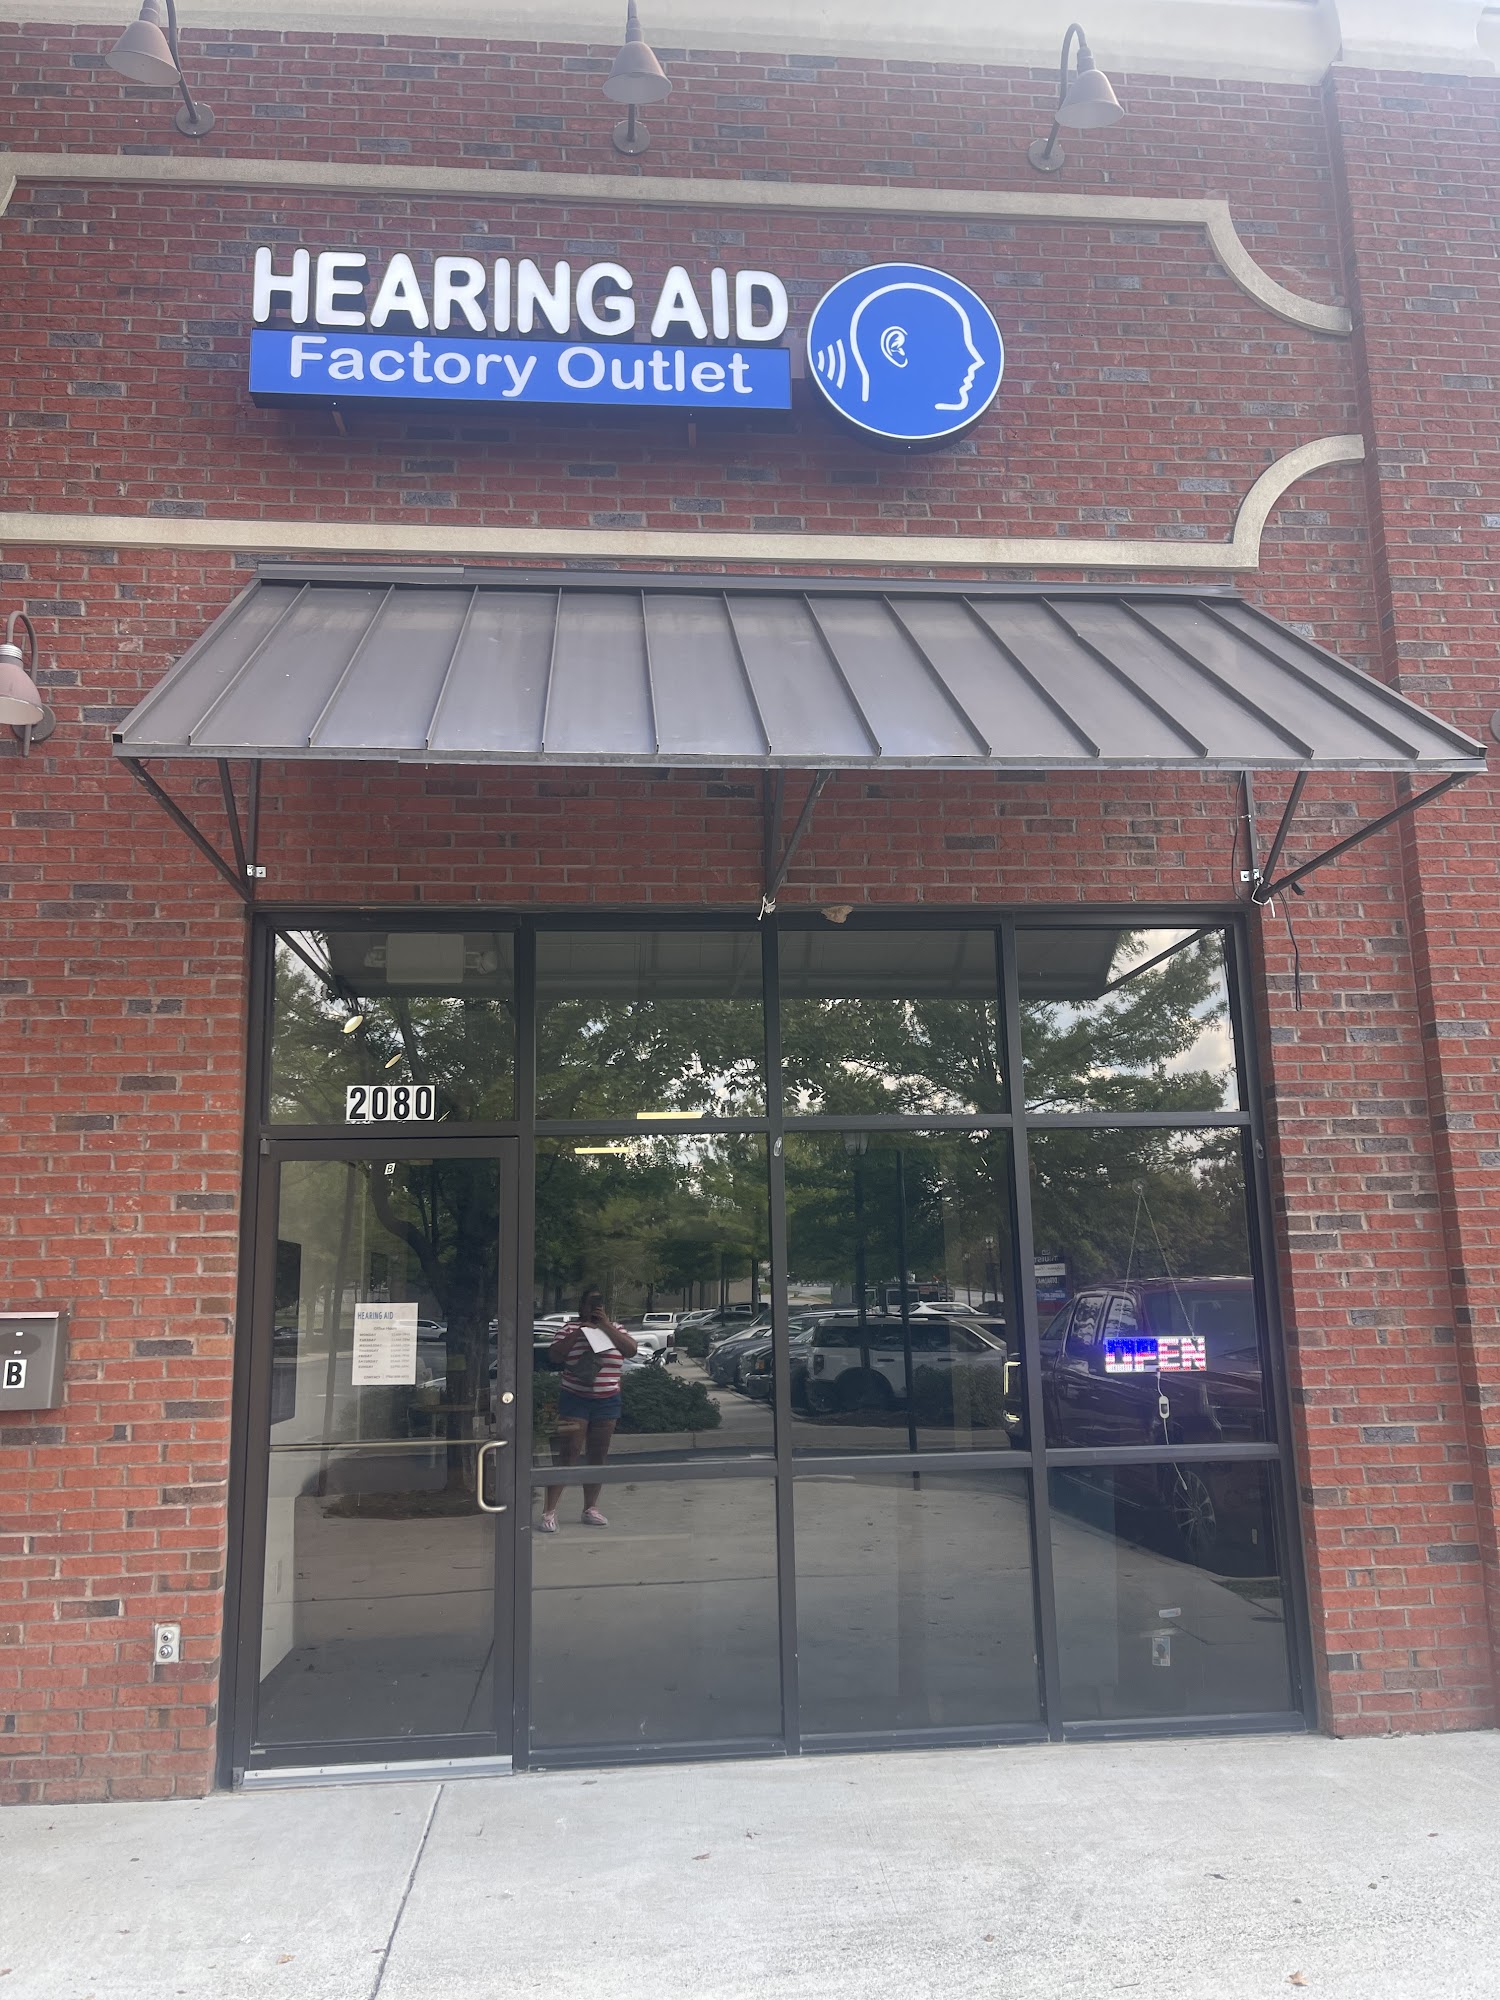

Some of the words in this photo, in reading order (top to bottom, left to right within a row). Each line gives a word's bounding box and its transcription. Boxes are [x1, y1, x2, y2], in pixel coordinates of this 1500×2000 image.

[253, 246, 636, 337] HEARING
[651, 265, 789, 341] AID
[289, 335, 538, 398] Factory
[557, 346, 754, 395] Outlet
[349, 1086, 432, 1120] 2080
[357, 1311, 383, 1319] HEARING
[384, 1311, 394, 1319] AID
[1104, 1337, 1206, 1372] OPEN
[6, 1361, 22, 1386] B
